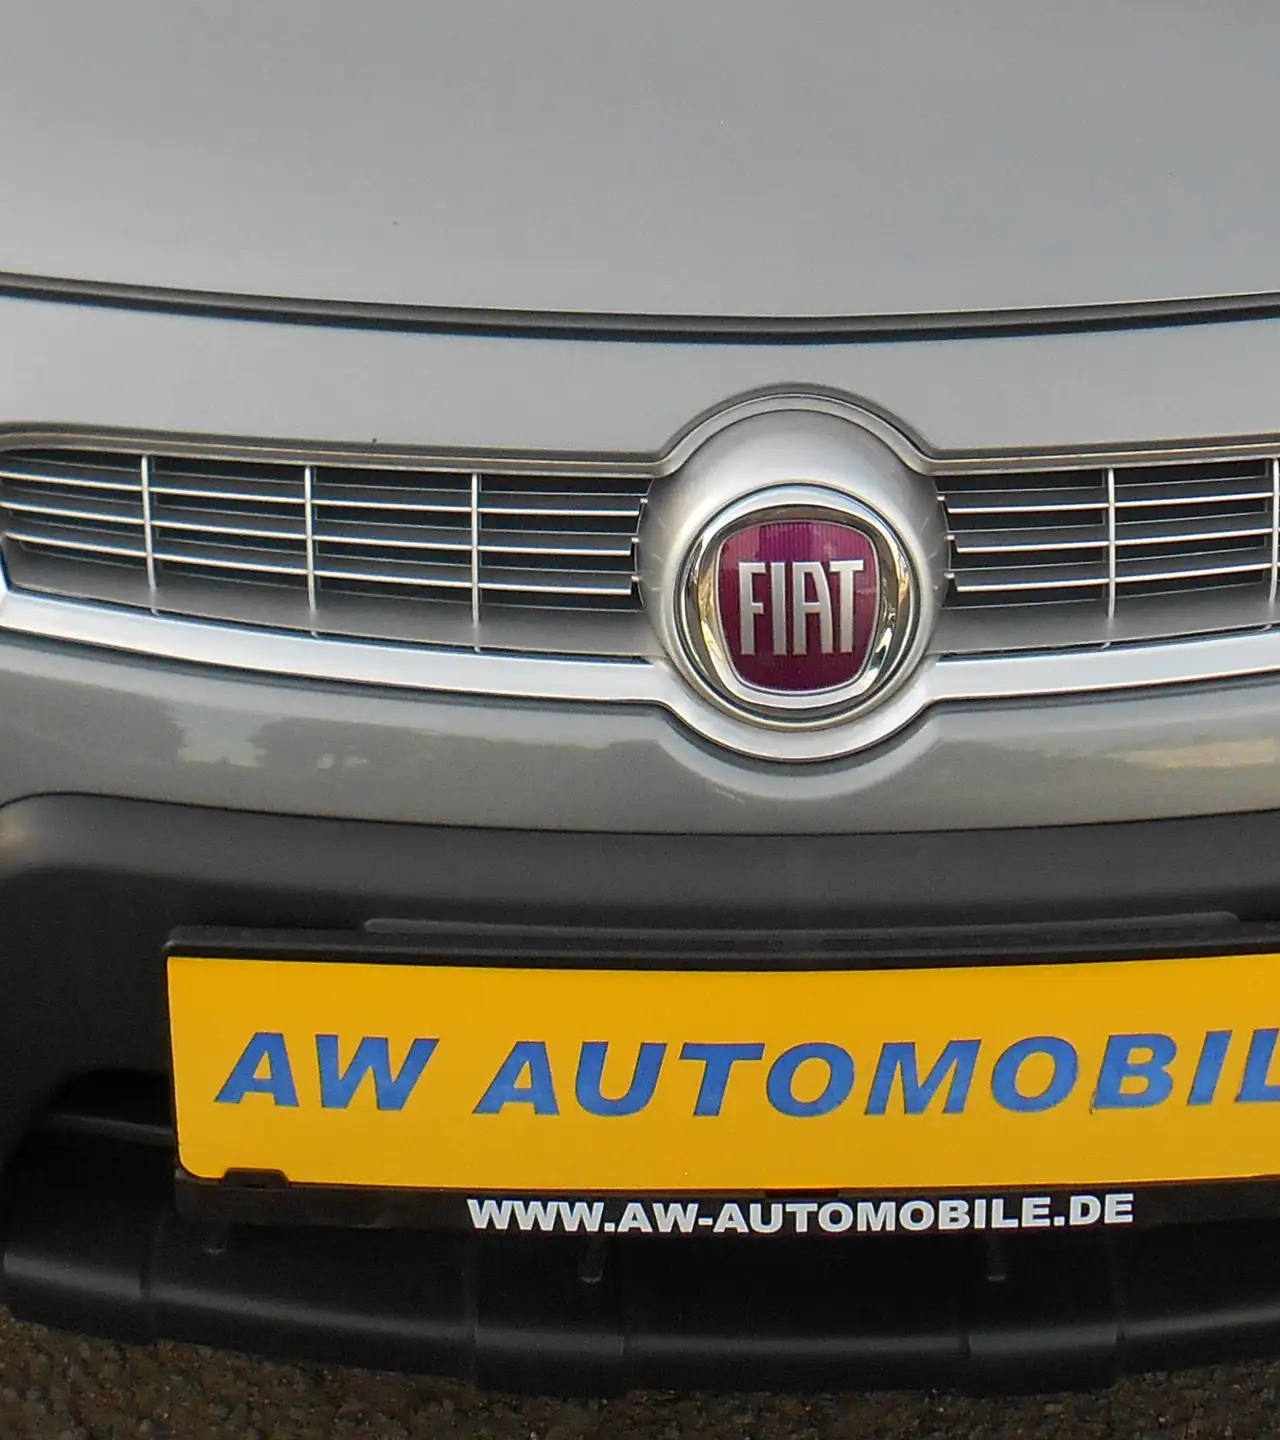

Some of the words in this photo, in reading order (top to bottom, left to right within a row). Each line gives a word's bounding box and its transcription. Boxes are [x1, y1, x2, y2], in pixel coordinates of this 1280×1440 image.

[737, 558, 865, 656] FIAT
[216, 1032, 439, 1111] AW
[466, 1192, 1135, 1234] WWW.AW-AUTOMOBILE.DE
